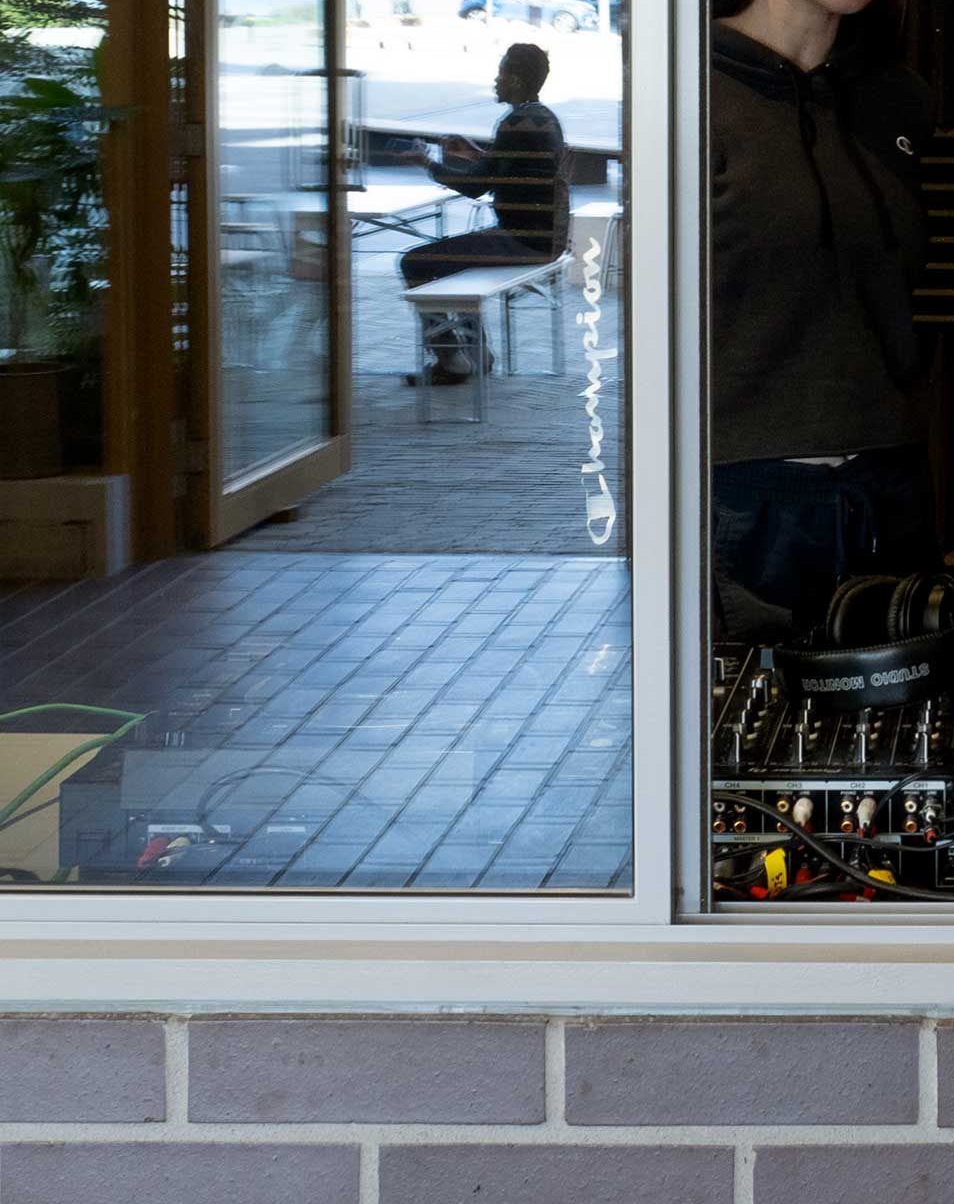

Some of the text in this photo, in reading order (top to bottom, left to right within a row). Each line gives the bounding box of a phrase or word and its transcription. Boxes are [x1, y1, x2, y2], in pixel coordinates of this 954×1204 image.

[576, 237, 618, 546] Champion
[801, 662, 931, 693] STUDIO MONITOR
